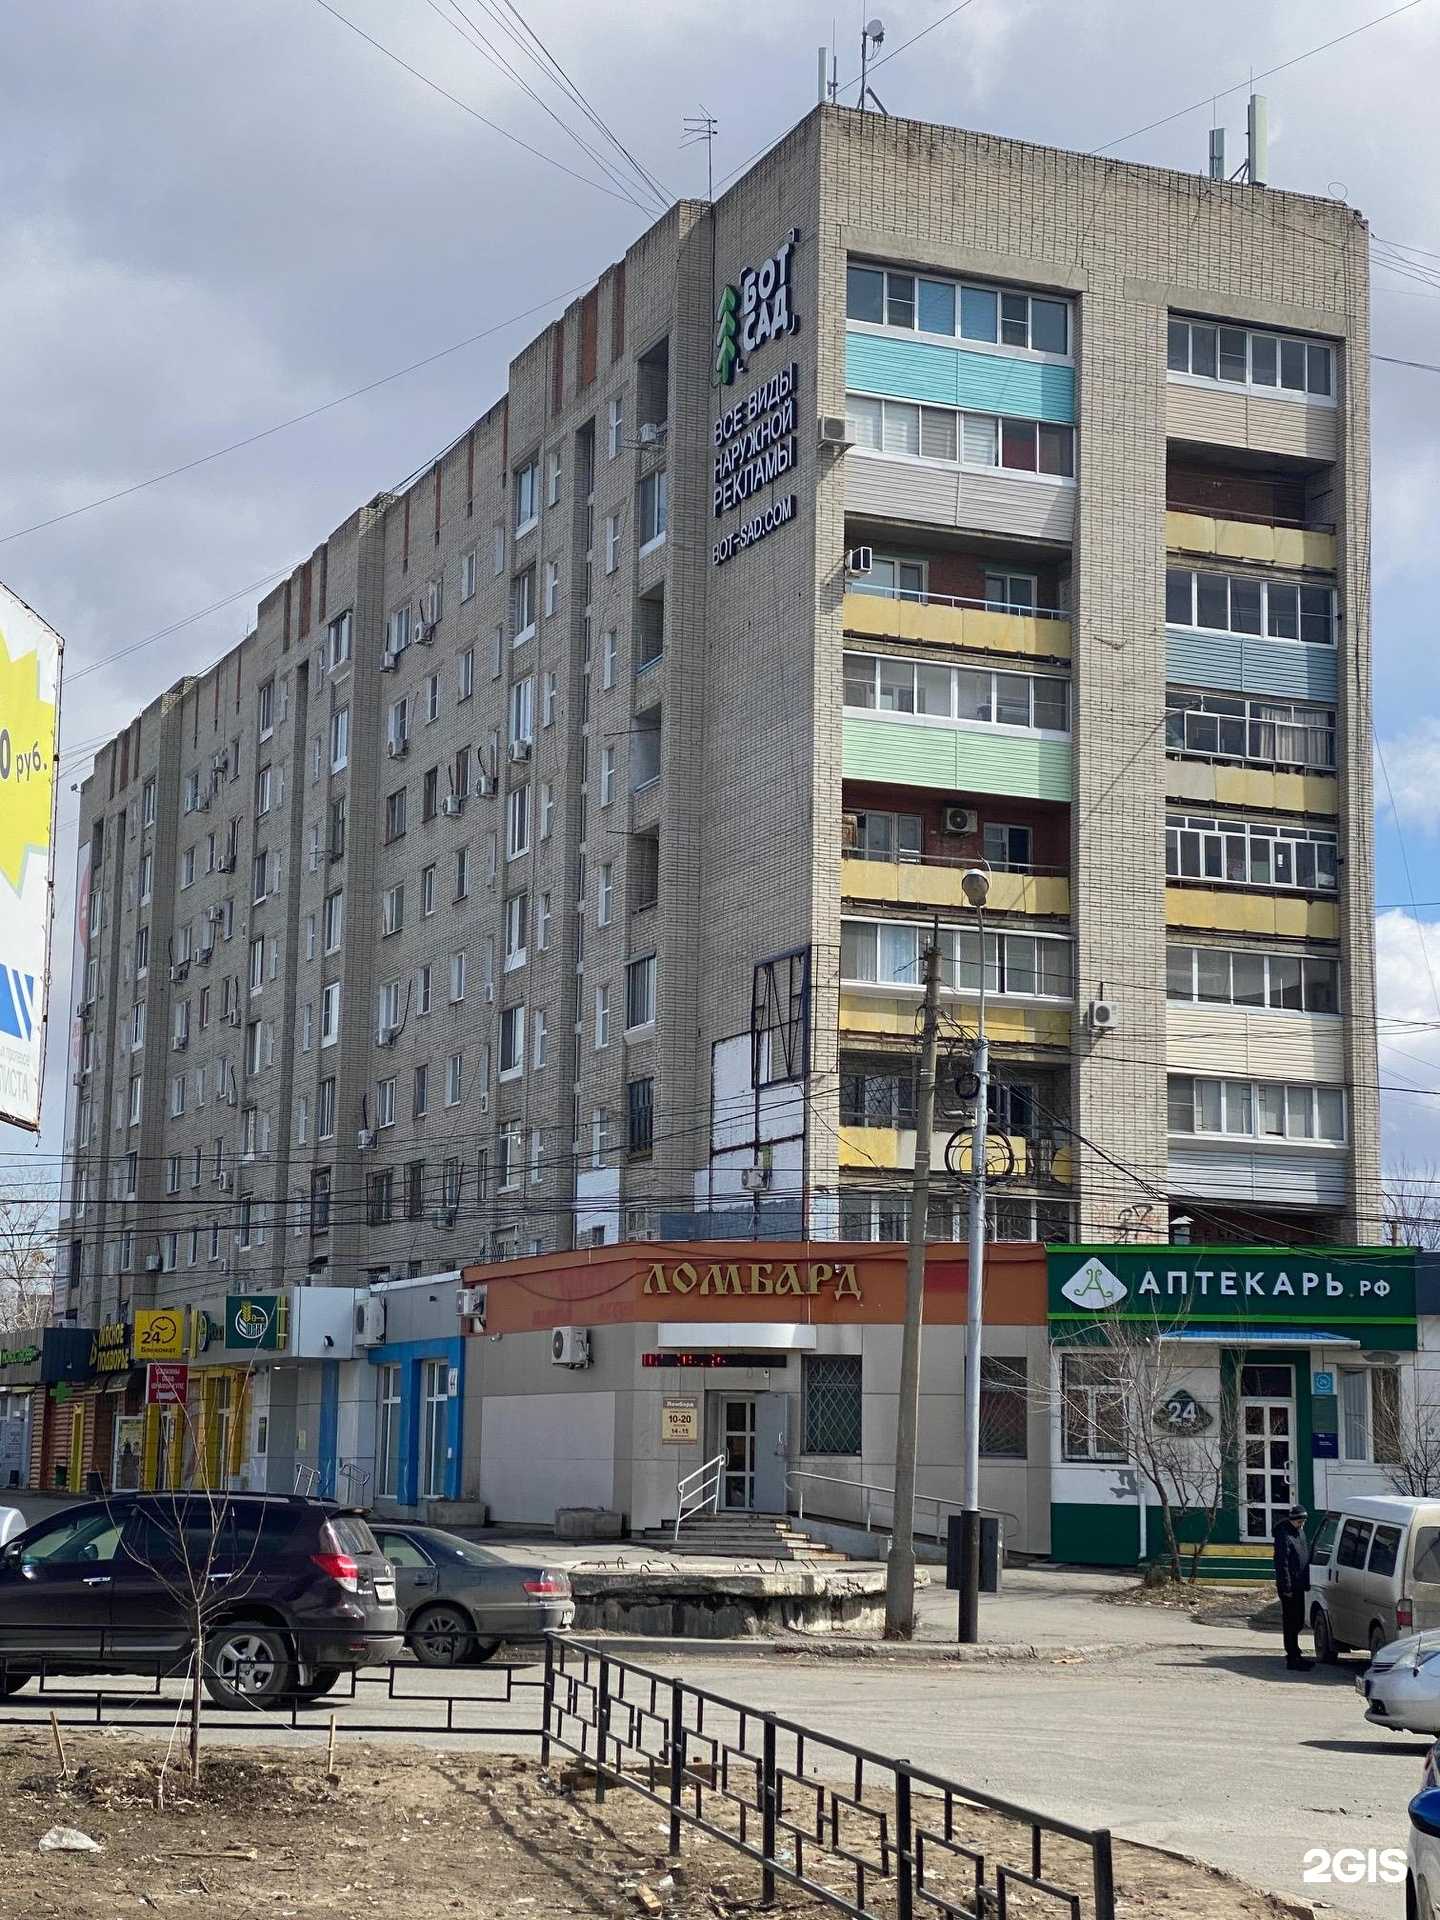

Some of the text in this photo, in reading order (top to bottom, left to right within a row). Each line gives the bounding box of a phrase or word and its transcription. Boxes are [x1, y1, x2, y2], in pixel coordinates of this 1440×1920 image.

[743, 242, 790, 315] БОТ
[743, 284, 789, 351] САД
[714, 362, 793, 447] ВСЕ ВИДЫ
[713, 399, 793, 483] НАРУЖНОЙ
[713, 436, 793, 518] РЕКЛАМЫ
[712, 495, 793, 566] BOT-SAD.COM
[16, 740, 48, 783] руб.
[643, 1262, 862, 1300] ЛОМБАРД
[141, 1331, 161, 1345] 24
[668, 1414, 692, 1424] 10-20
[1168, 1401, 1196, 1422] 24
